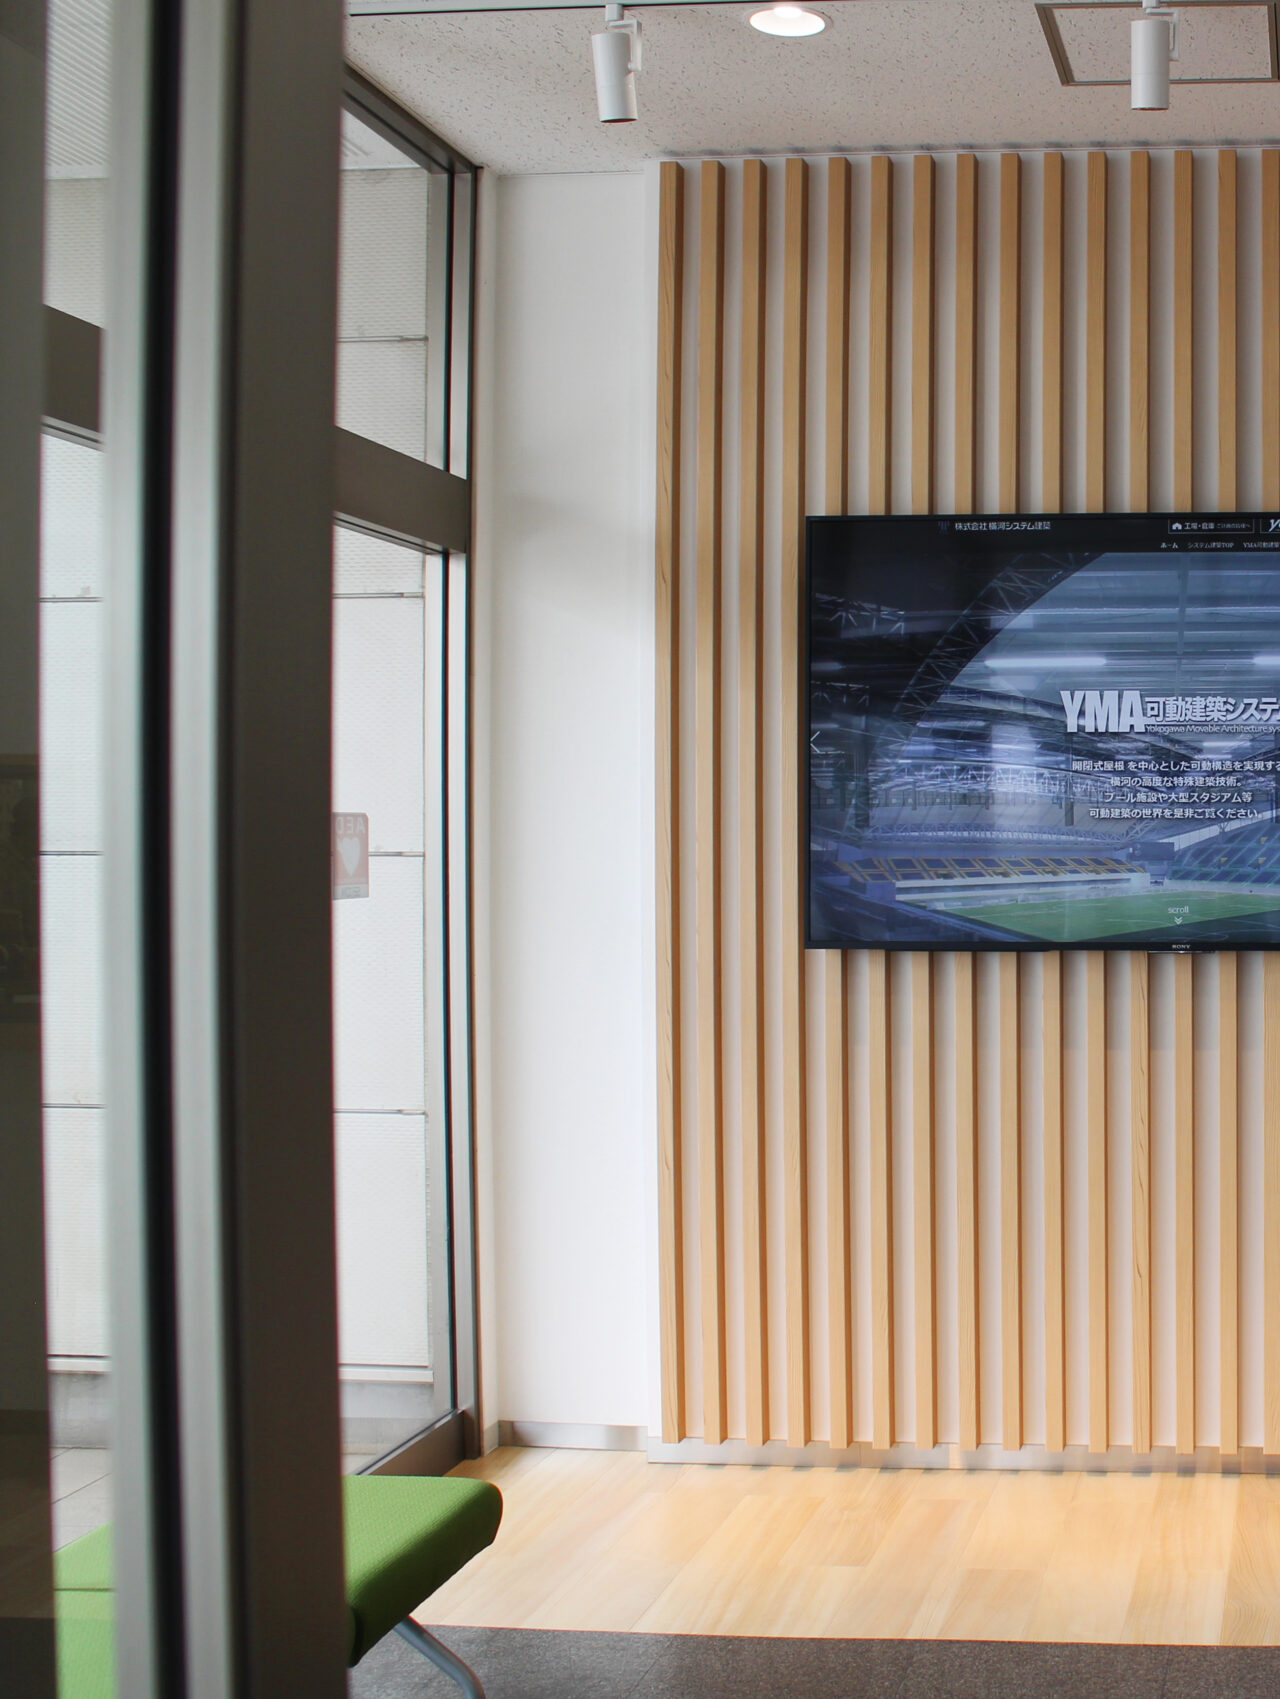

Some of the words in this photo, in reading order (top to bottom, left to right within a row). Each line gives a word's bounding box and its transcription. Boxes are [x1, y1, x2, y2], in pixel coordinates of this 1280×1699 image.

[955, 522, 987, 530] 株式会社
[989, 522, 1051, 530] 横河システム建築
[1186, 725, 1220, 733] Movable
[1222, 725, 1267, 733] Architecture
[1072, 761, 1125, 771] 開閉式屋根
[1168, 905, 1189, 914] scroll
